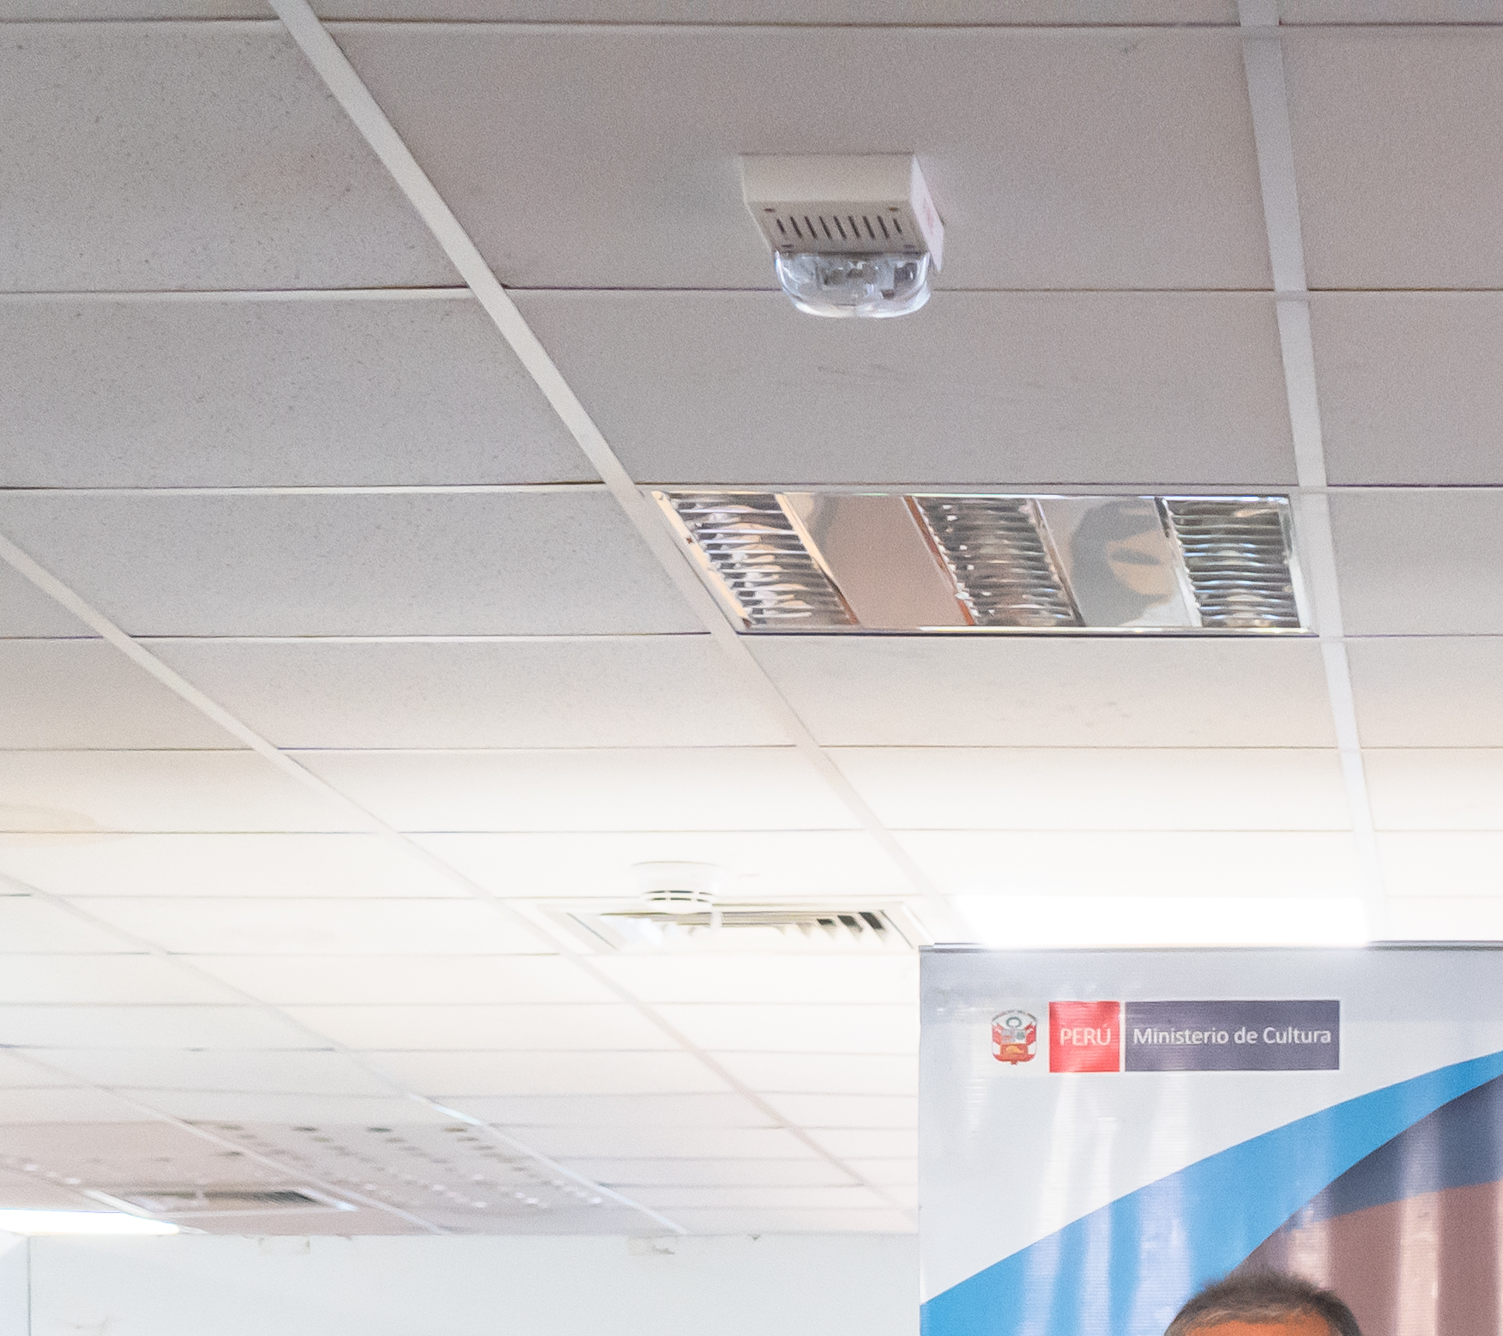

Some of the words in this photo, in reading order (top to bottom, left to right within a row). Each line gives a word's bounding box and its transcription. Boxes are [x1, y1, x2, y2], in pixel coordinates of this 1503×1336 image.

[1059, 1022, 1112, 1047] PERÚ
[1133, 1026, 1230, 1046] Ministerio
[1234, 1026, 1258, 1045] de
[1262, 1025, 1332, 1045] Cultura
